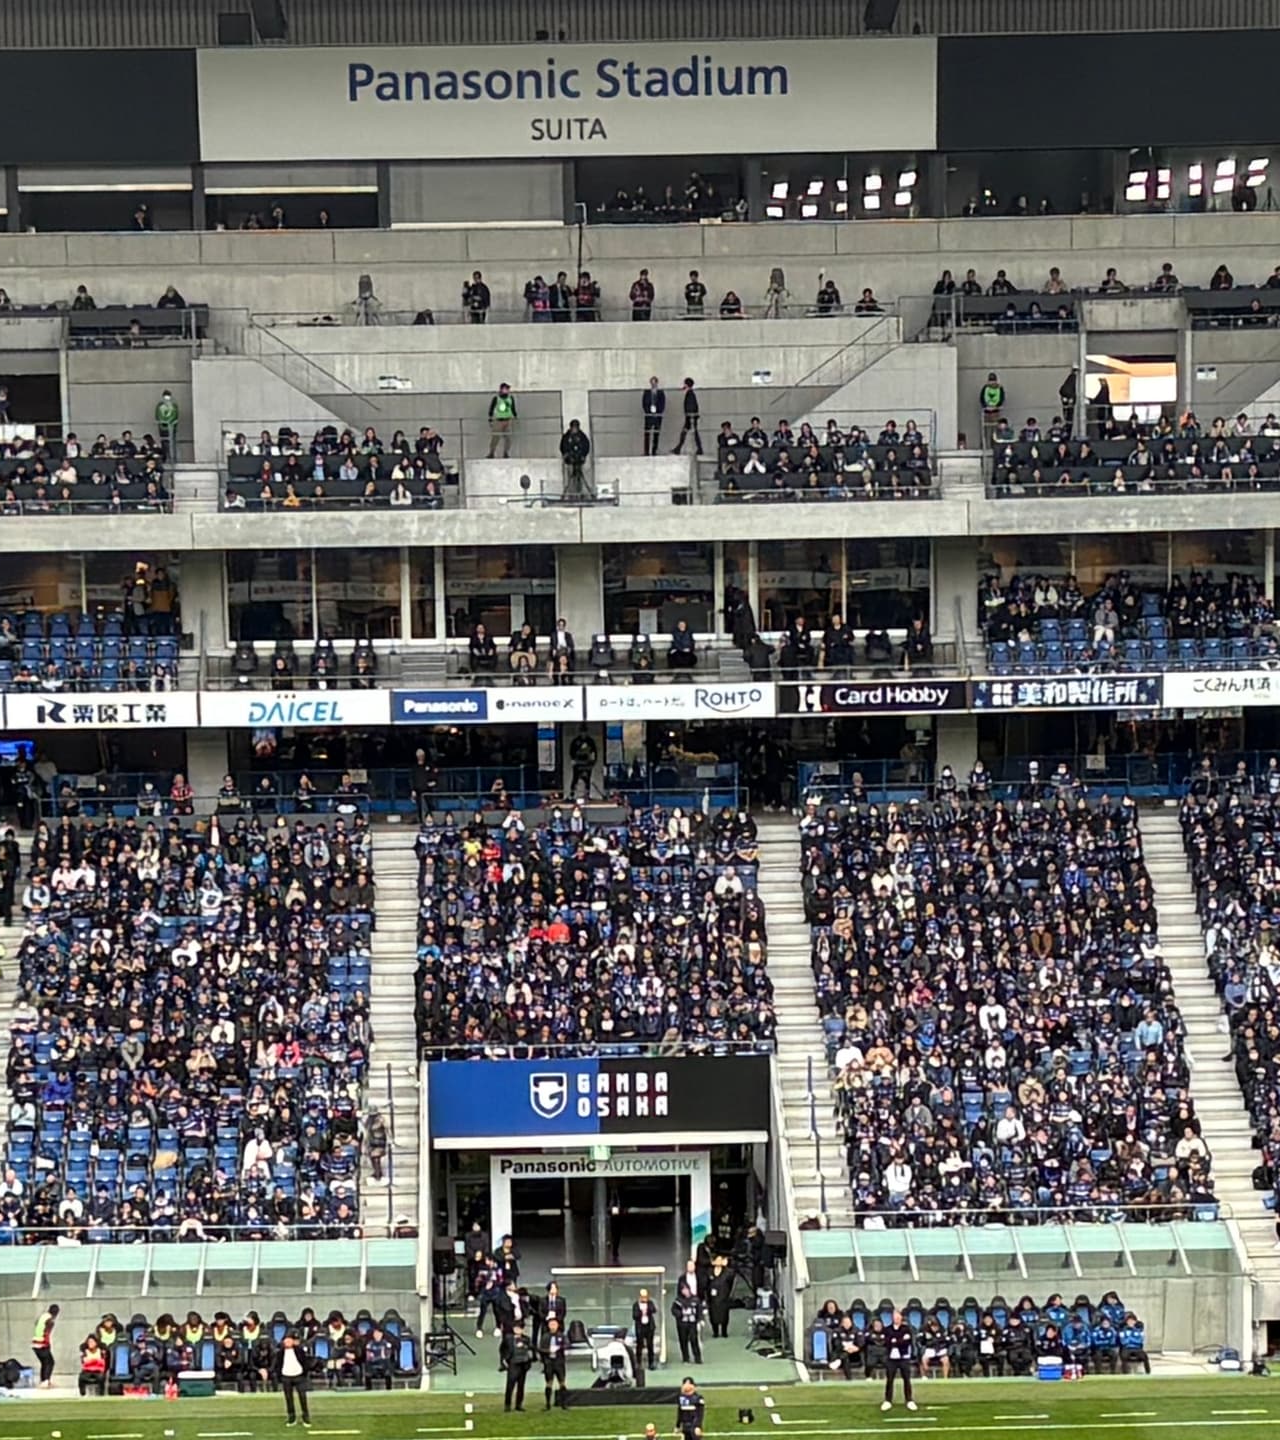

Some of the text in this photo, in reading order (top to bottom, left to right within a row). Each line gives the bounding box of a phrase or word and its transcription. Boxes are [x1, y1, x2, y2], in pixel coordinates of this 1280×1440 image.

[348, 54, 789, 103] Panasonic Stadium
[530, 117, 607, 142] SUITA
[694, 688, 762, 713] ROHTO
[834, 687, 882, 705] Card
[886, 686, 950, 706] Hobby
[1017, 680, 1138, 706] 美和製作所
[248, 701, 344, 722] DAICEL
[403, 698, 479, 714] Panasonic
[577, 1072, 669, 1094] GAMBA
[577, 1095, 669, 1118] OSAKA
[500, 1157, 701, 1175] Panasonic AUTOMOTIVE
